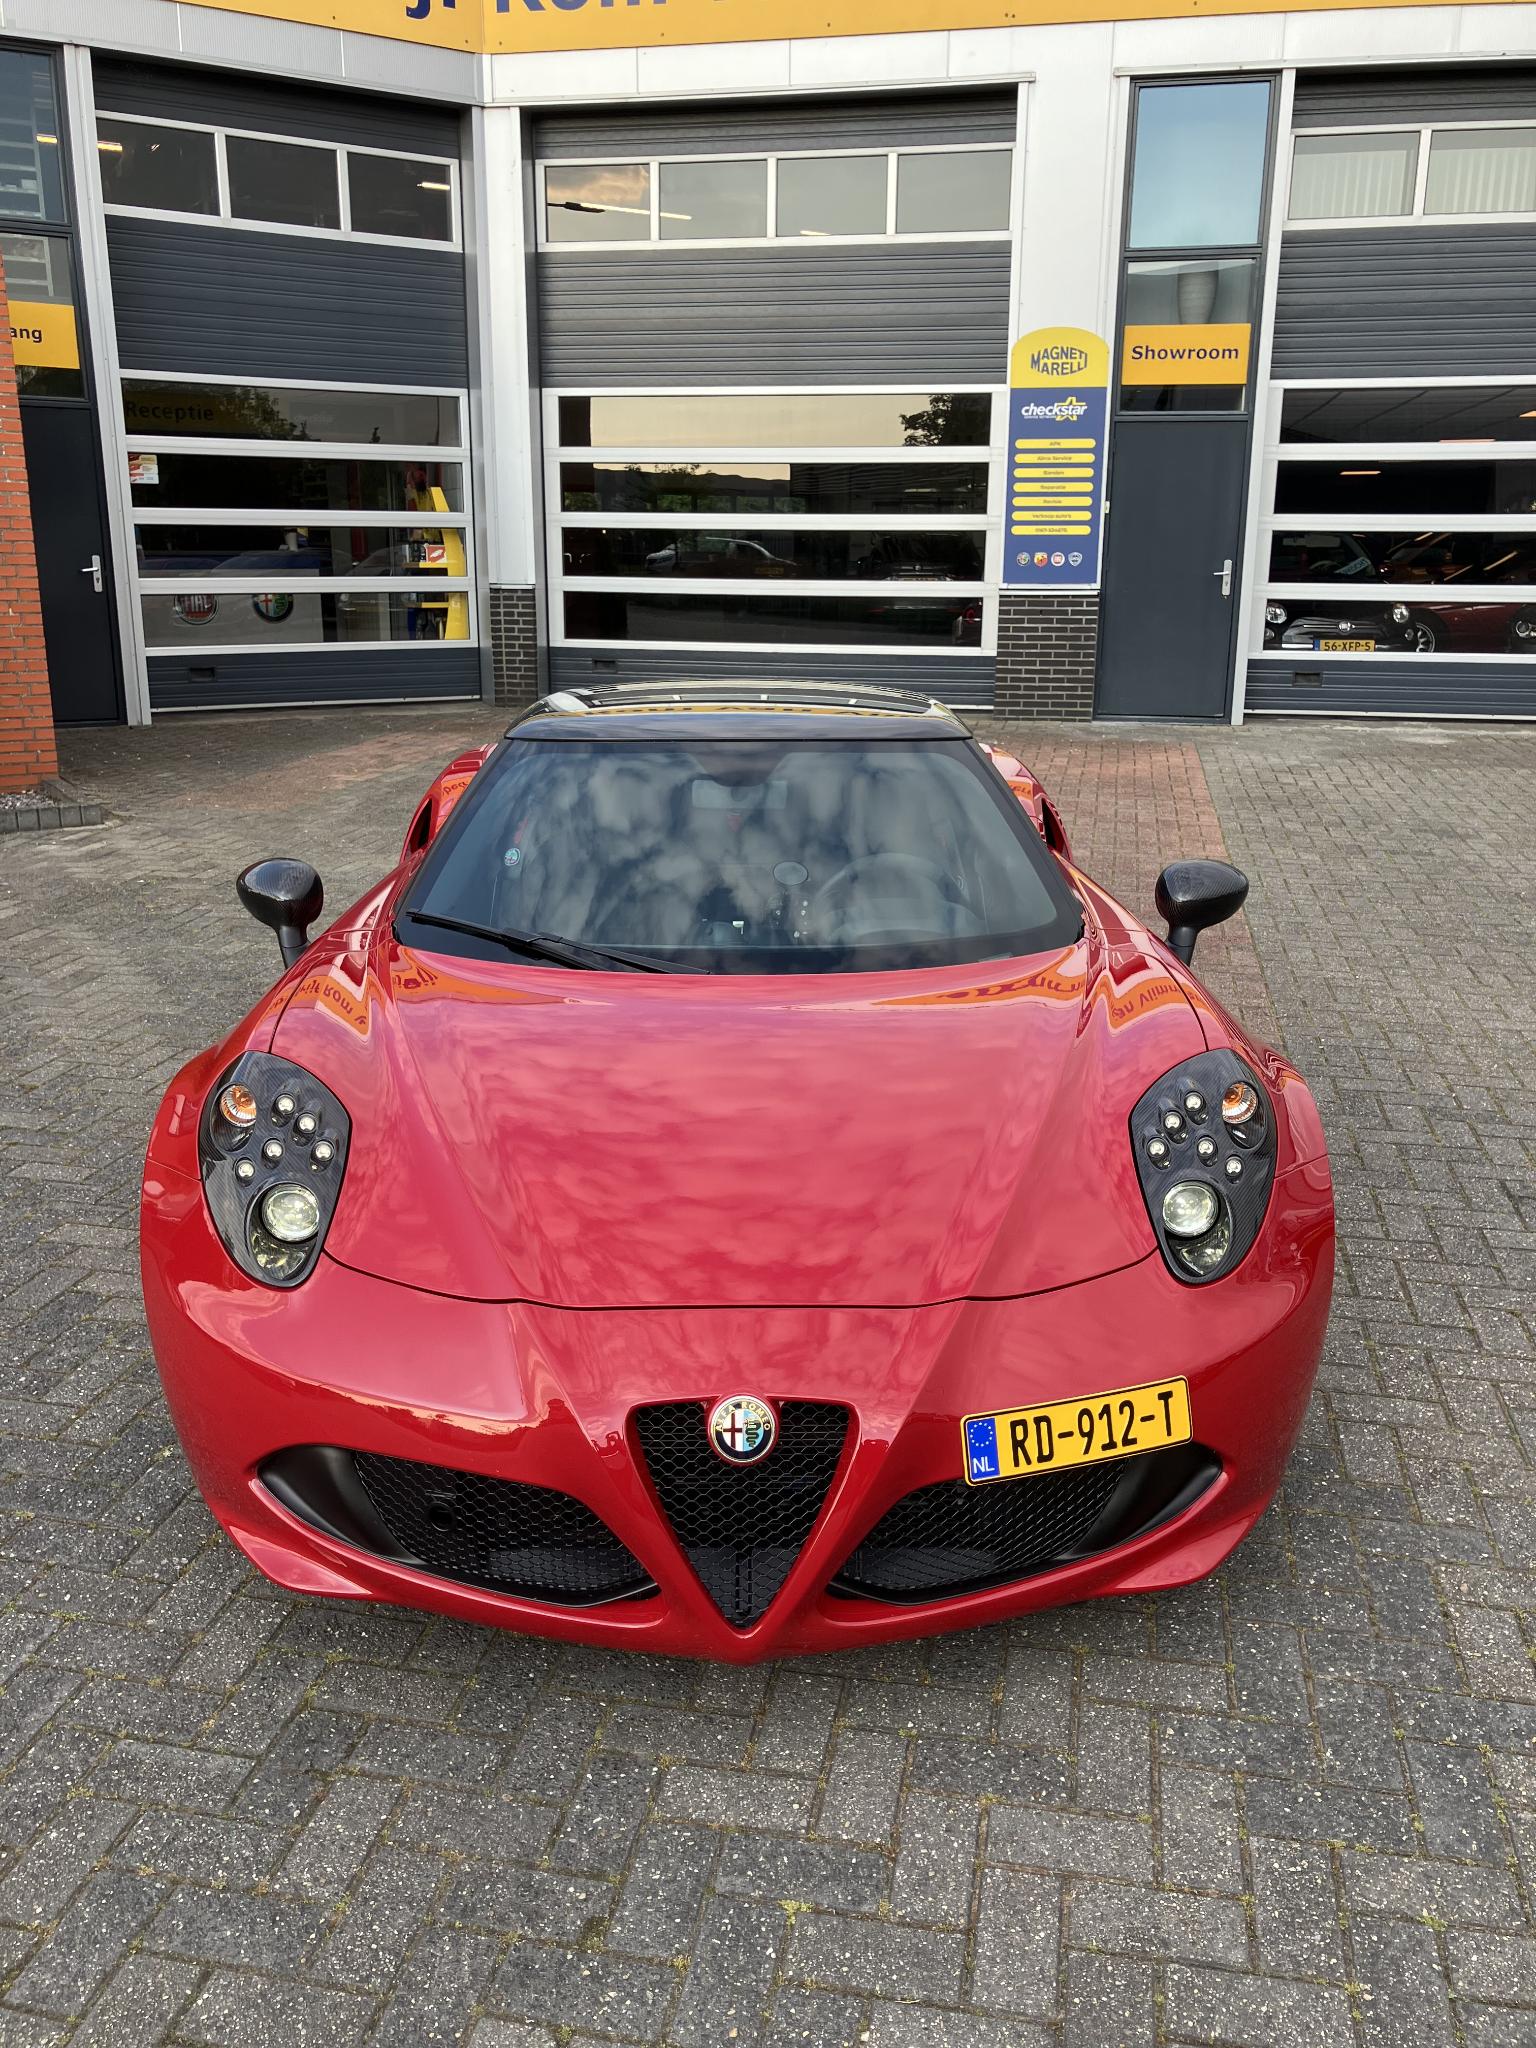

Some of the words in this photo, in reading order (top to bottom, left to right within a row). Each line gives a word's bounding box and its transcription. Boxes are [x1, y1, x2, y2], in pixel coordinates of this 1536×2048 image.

[1131, 345, 1239, 360] Showroom
[126, 401, 215, 423] Receptie
[1021, 402, 1088, 416] checkstar
[1324, 642, 1370, 652] 56-XFP-S
[715, 1405, 736, 1431] ALFA
[741, 1401, 771, 1431] ROMEO
[1010, 1391, 1173, 1468] RD-912-T
[973, 1456, 995, 1474] NL
